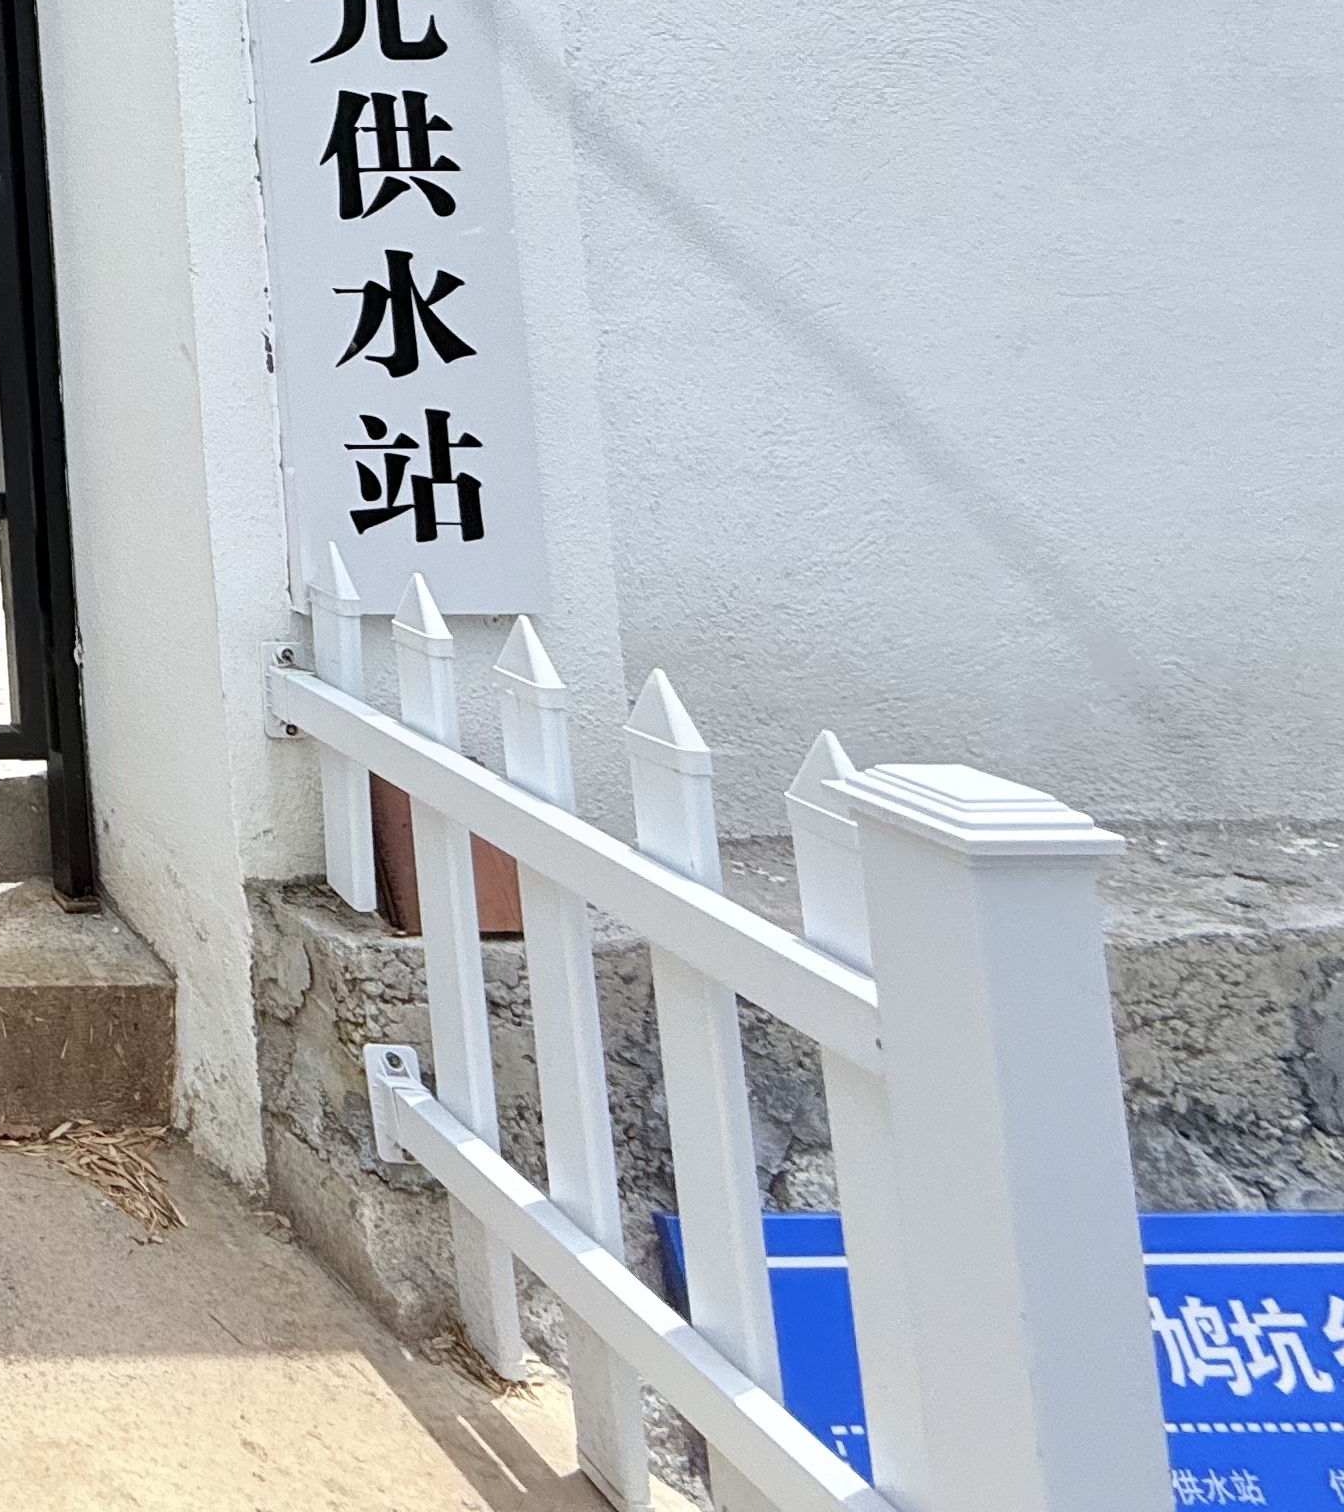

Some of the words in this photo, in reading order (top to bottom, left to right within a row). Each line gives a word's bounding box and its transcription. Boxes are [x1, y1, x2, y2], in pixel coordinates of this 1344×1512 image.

[1148, 1295, 1344, 1396] 鸠坑
[1171, 1468, 1267, 1506] 供水站
